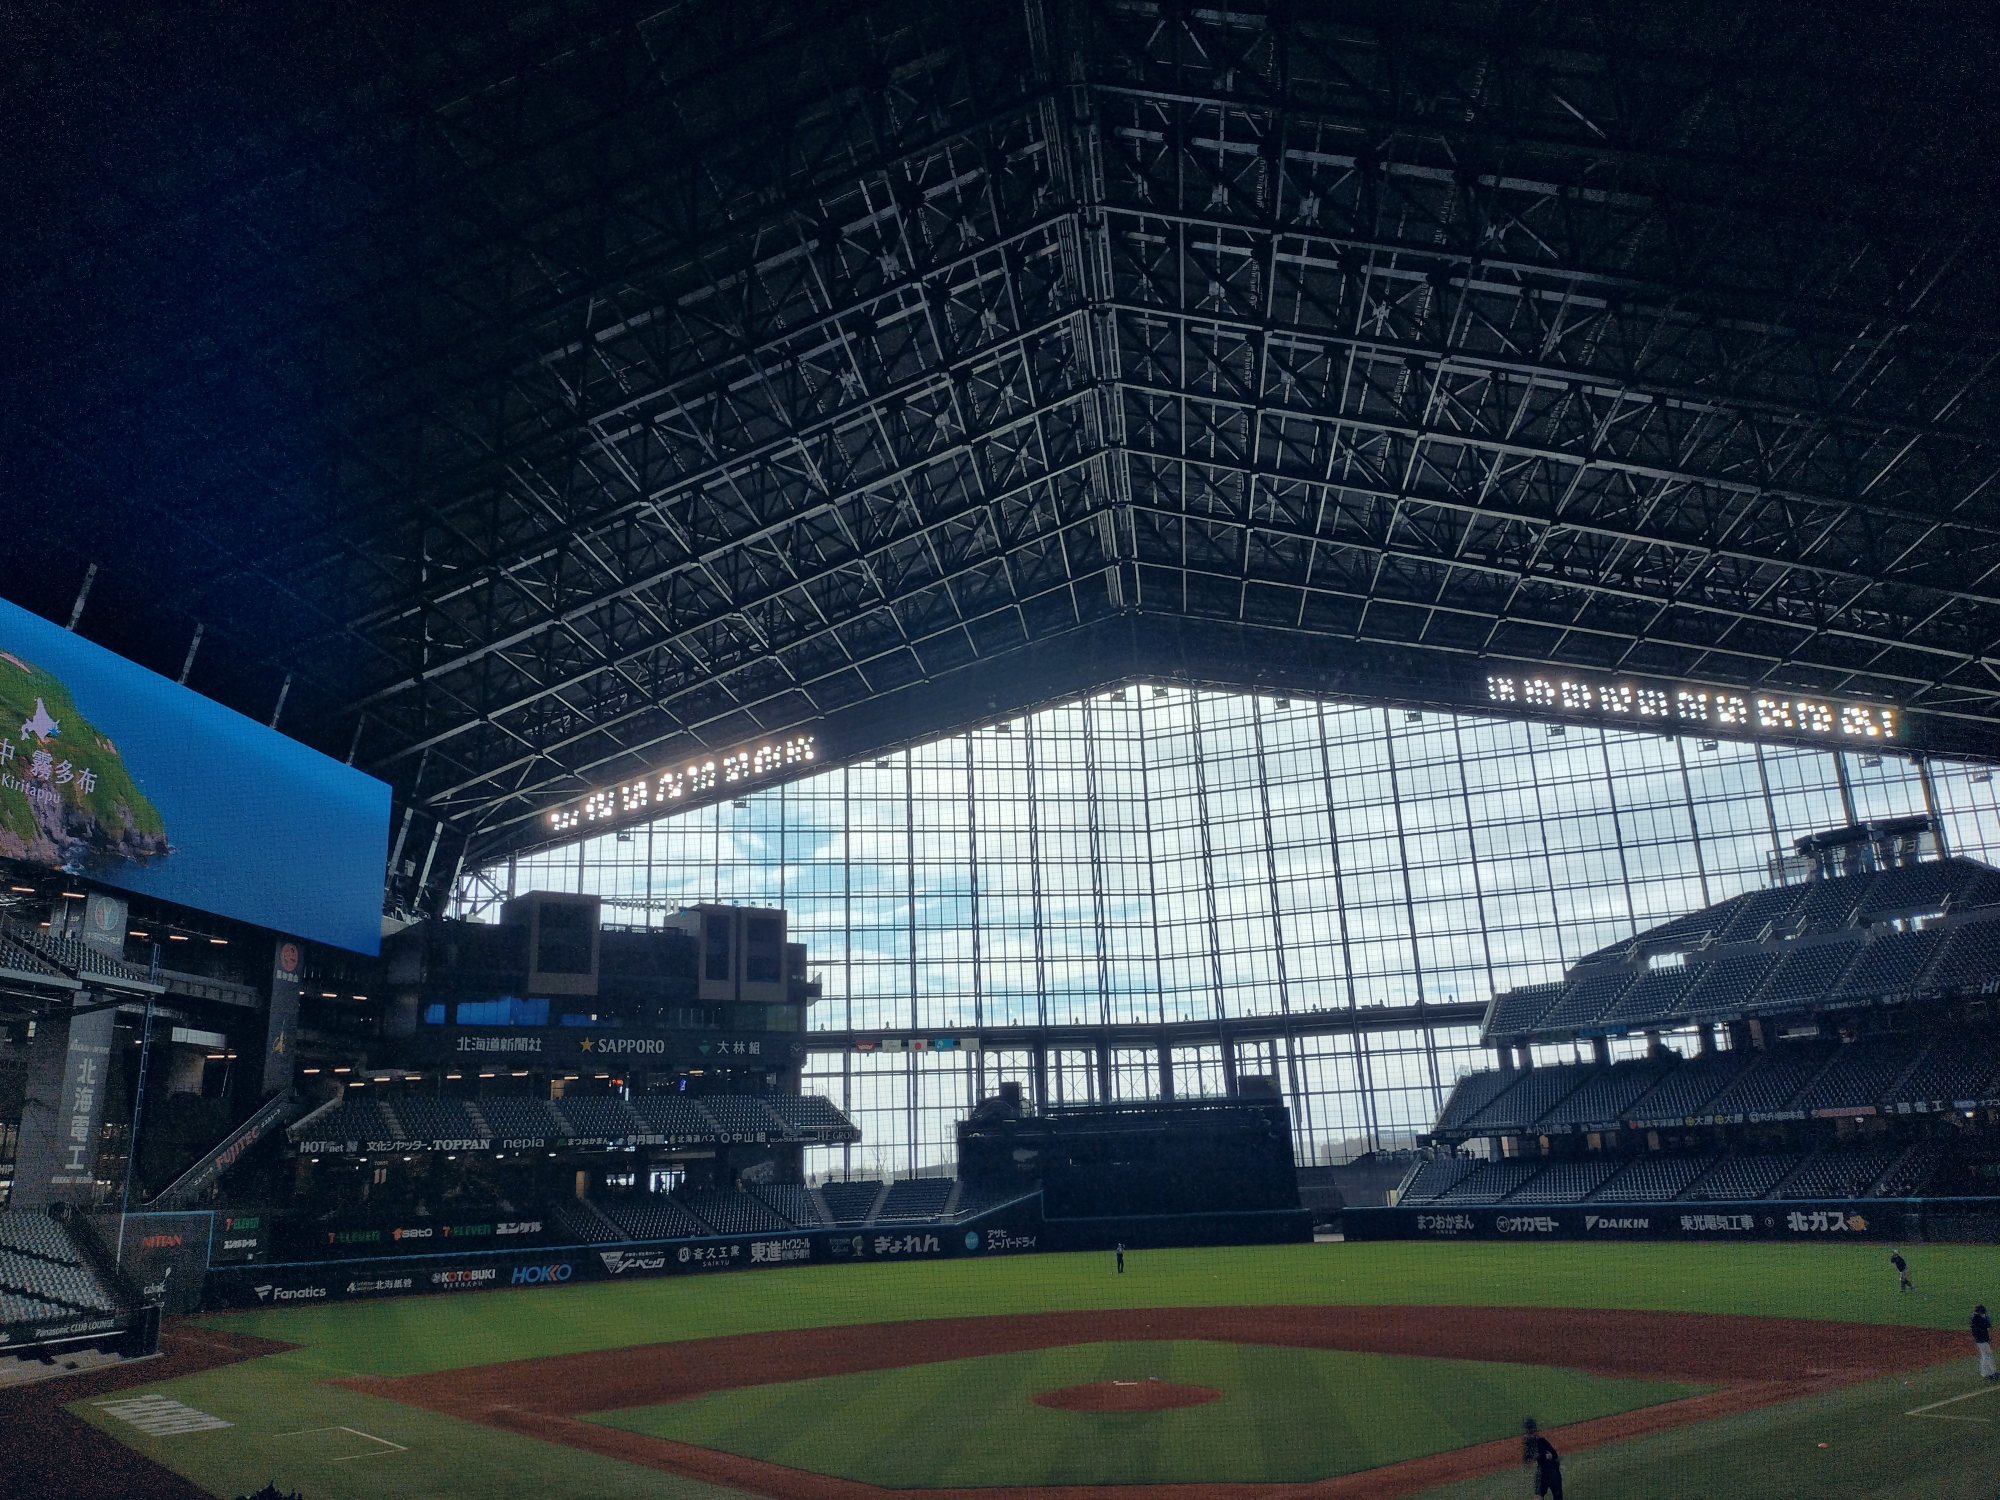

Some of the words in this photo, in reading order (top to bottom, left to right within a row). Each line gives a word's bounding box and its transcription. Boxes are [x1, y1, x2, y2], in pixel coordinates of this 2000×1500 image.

[31, 750, 98, 795] 霧多布
[2, 773, 61, 805] Kiritappu
[456, 1037, 542, 1053] 北海道新聞社
[596, 1039, 665, 1054] SAPPORO
[717, 1041, 761, 1055] 大林組
[432, 1139, 491, 1151] TOPPAN
[502, 1137, 545, 1149] nepia
[731, 1132, 766, 1144] 中山組
[495, 1220, 543, 1234] ユンケル
[1510, 1216, 1560, 1232] オカモト
[1599, 1218, 1649, 1229] DAIKIN
[1680, 1215, 1754, 1231] 東光電気工事
[1787, 1211, 1849, 1232] 北ガス
[987, 1229, 1007, 1239] アサヒ
[874, 1234, 940, 1254] ぎょれん
[987, 1236, 1037, 1250] スーパードライ
[750, 1241, 781, 1264] 東進
[702, 1260, 730, 1268] SAIKYU
[441, 1269, 495, 1283] KOTOBUKI
[273, 1286, 326, 1300] Fanatics
